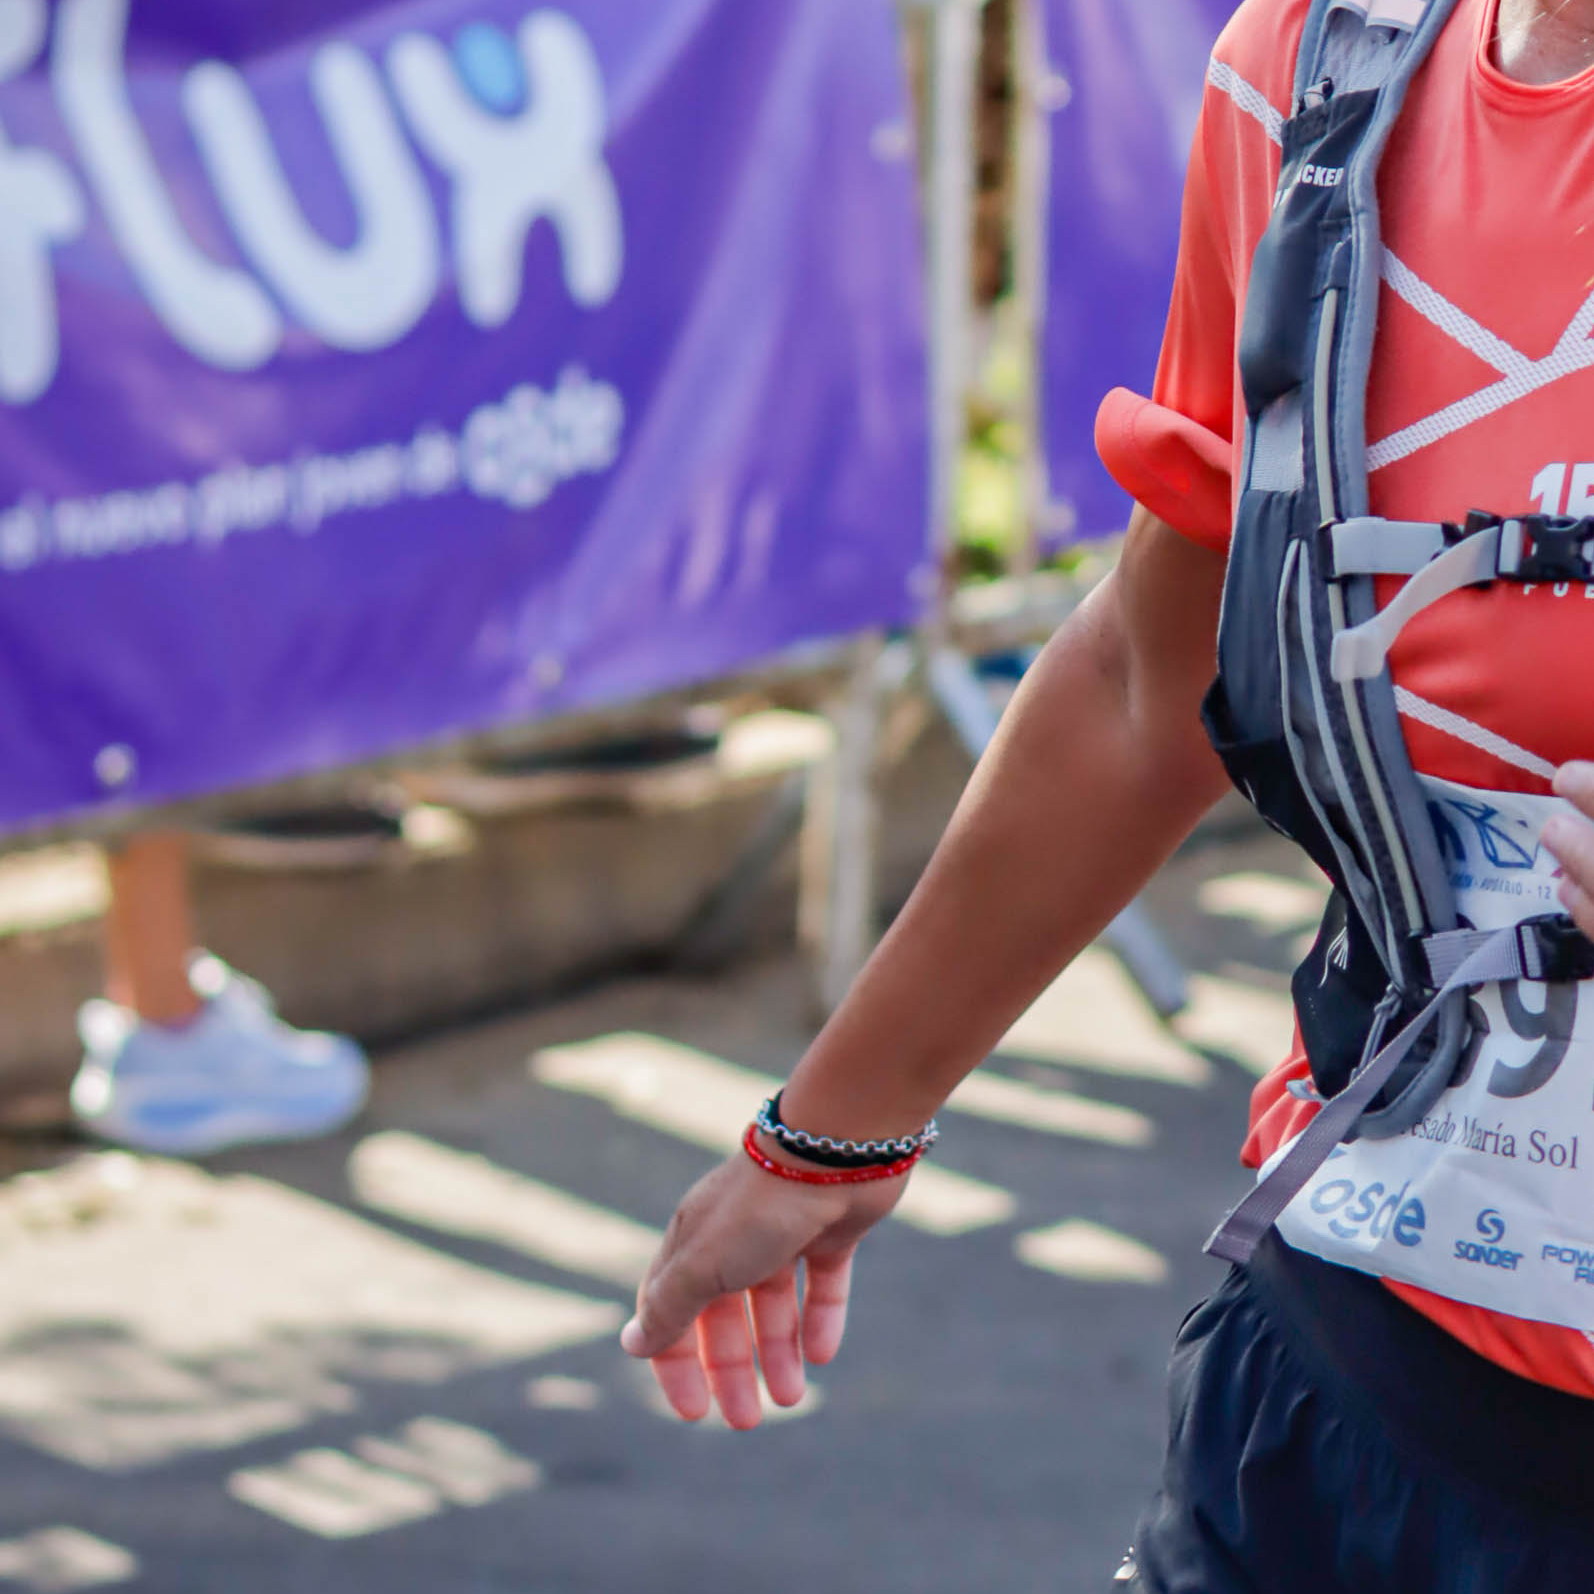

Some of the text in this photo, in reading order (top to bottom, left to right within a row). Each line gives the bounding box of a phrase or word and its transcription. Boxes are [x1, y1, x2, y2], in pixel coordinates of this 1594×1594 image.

[1400, 1112, 1579, 1169] esado María Sol
